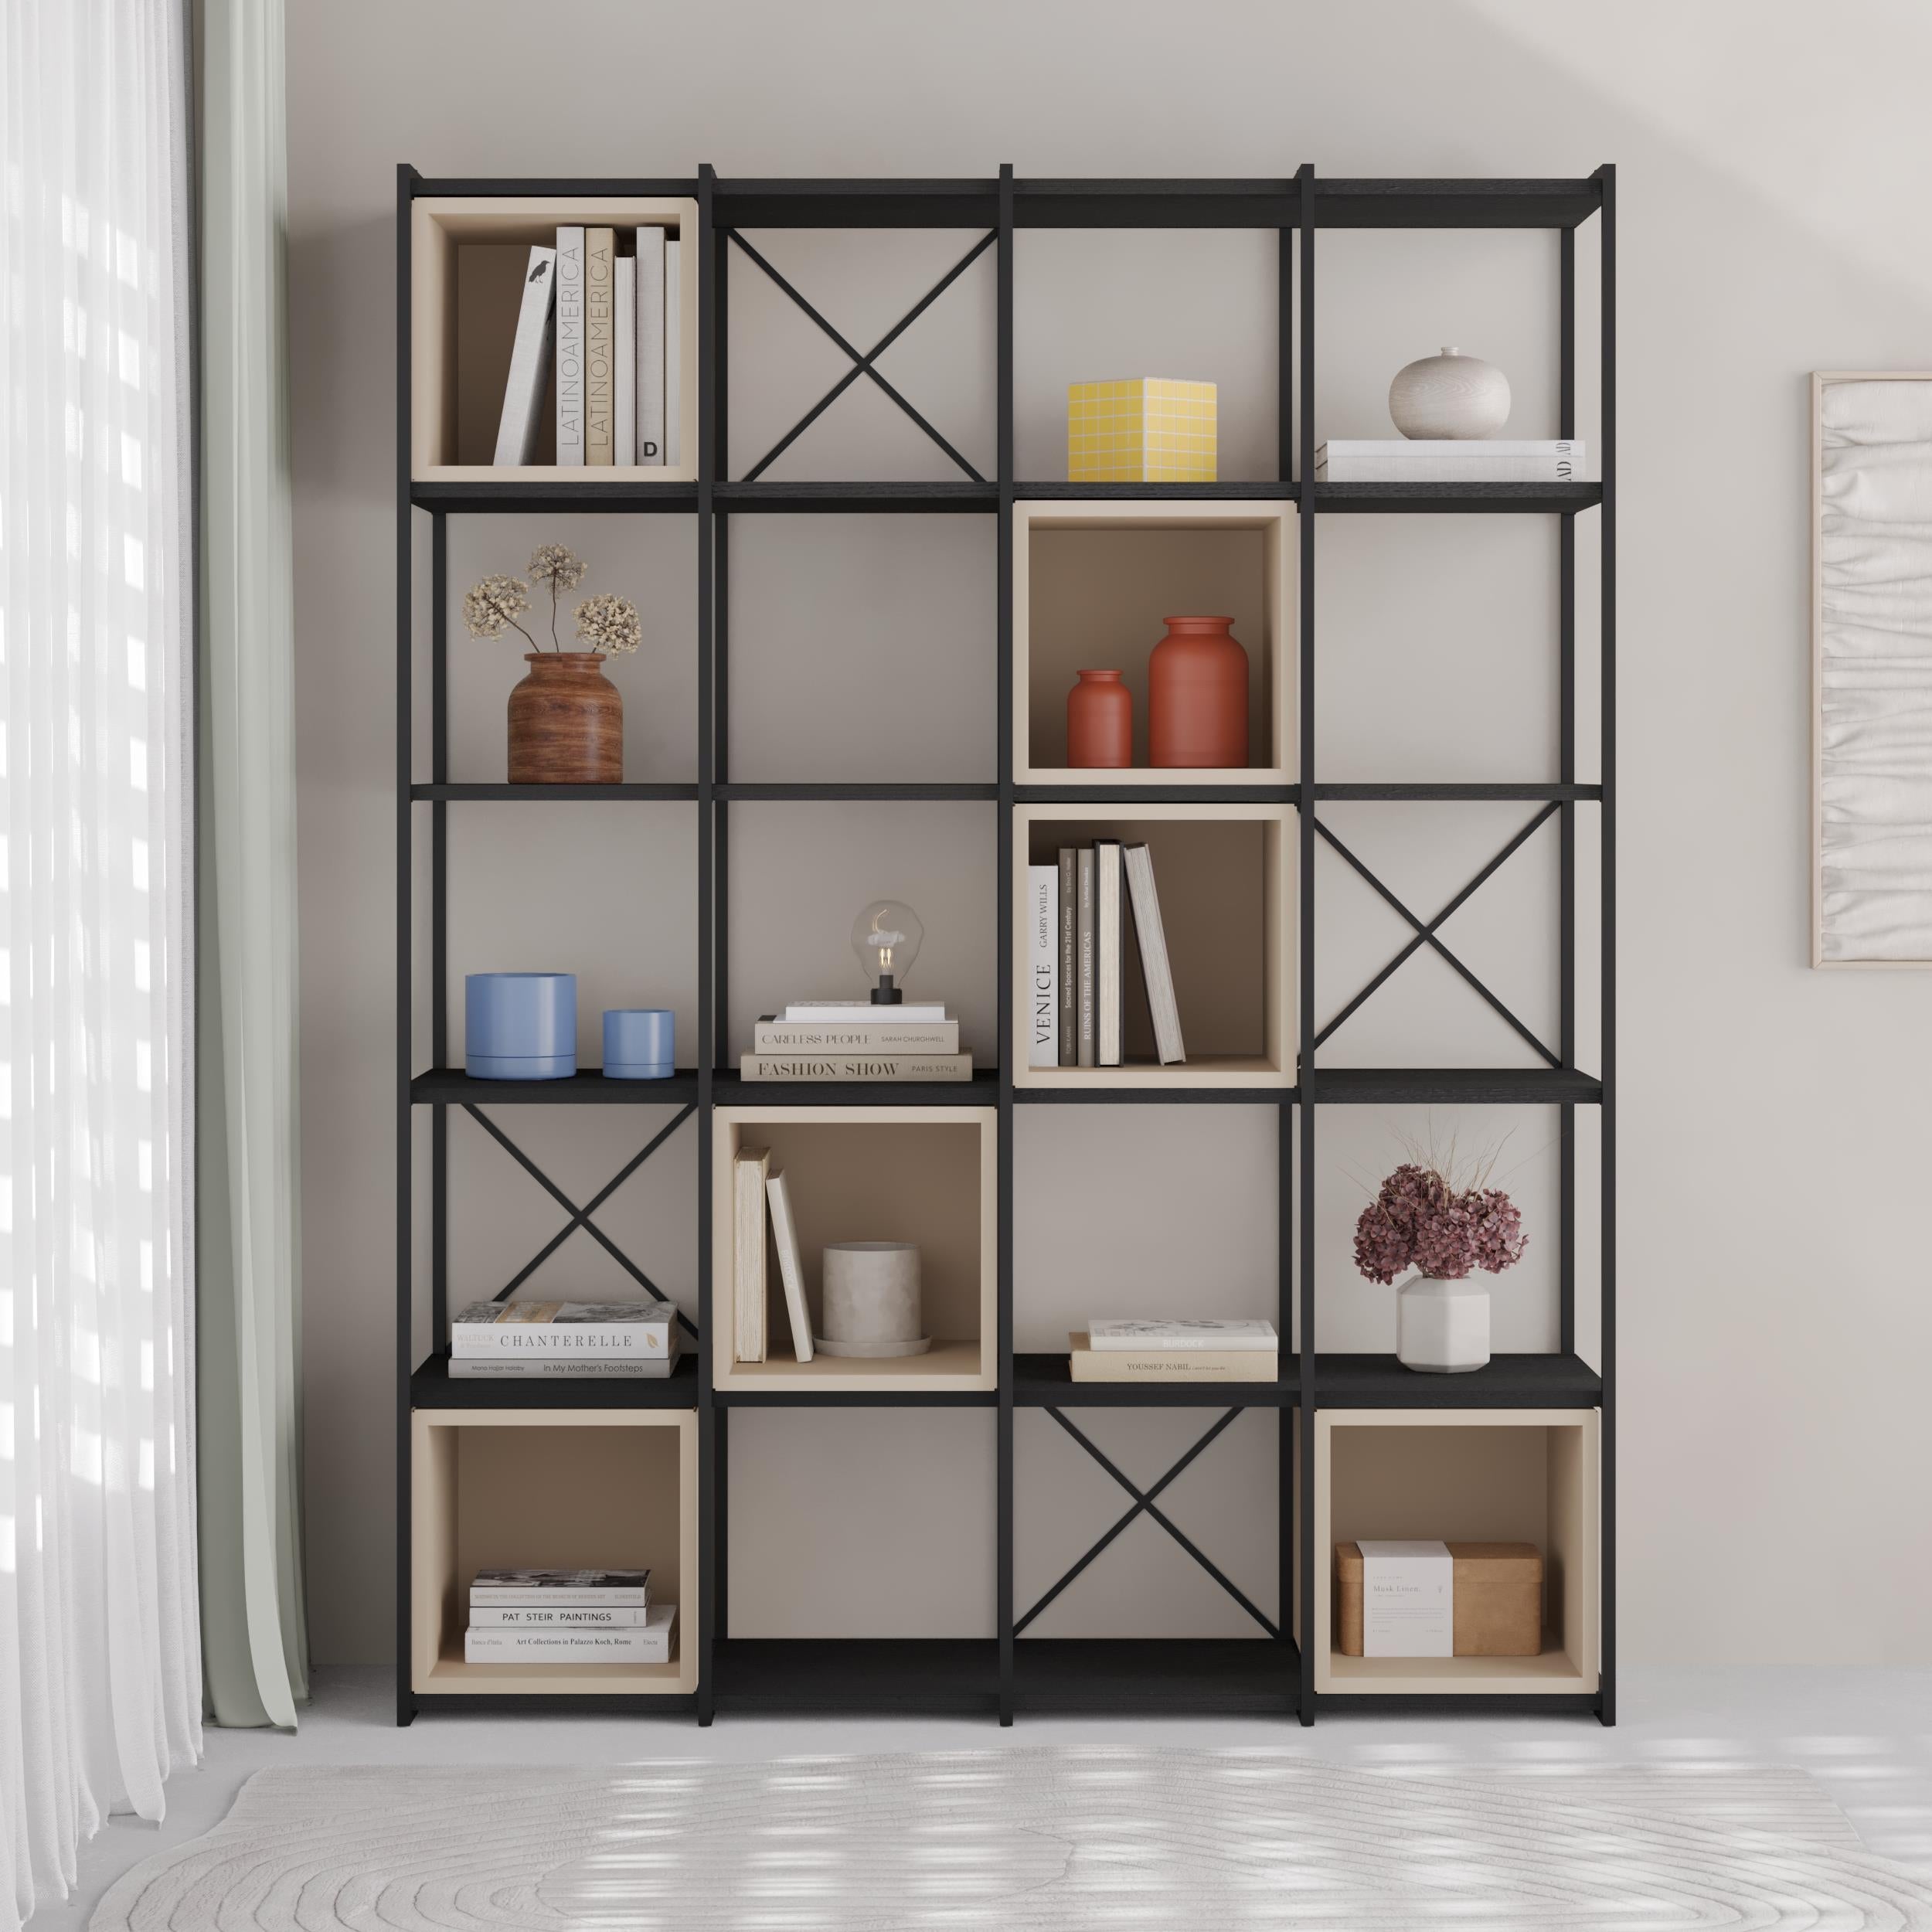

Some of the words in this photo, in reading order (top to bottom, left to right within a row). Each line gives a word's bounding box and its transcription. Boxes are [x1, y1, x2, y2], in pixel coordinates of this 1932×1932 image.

[562, 247, 579, 445] LATINOAMERICA
[590, 247, 608, 446] LATINOAMERICA
[644, 441, 658, 457] D
[1036, 964, 1051, 1045] VENICE
[1083, 998, 1091, 1012] OF
[762, 1035, 822, 1044] CARELESS
[826, 1035, 872, 1044] PEOPLE
[758, 1063, 836, 1076] FASHION
[845, 1063, 900, 1076] SHOW
[500, 1335, 633, 1347] CHANTERELLE
[553, 1364, 566, 1373] My
[604, 1364, 644, 1373] Footsteps
[502, 1613, 520, 1621] PAT
[526, 1613, 553, 1621] STEIR
[560, 1613, 612, 1621] PAINTINGS
[594, 1638, 613, 1647] Koch,
